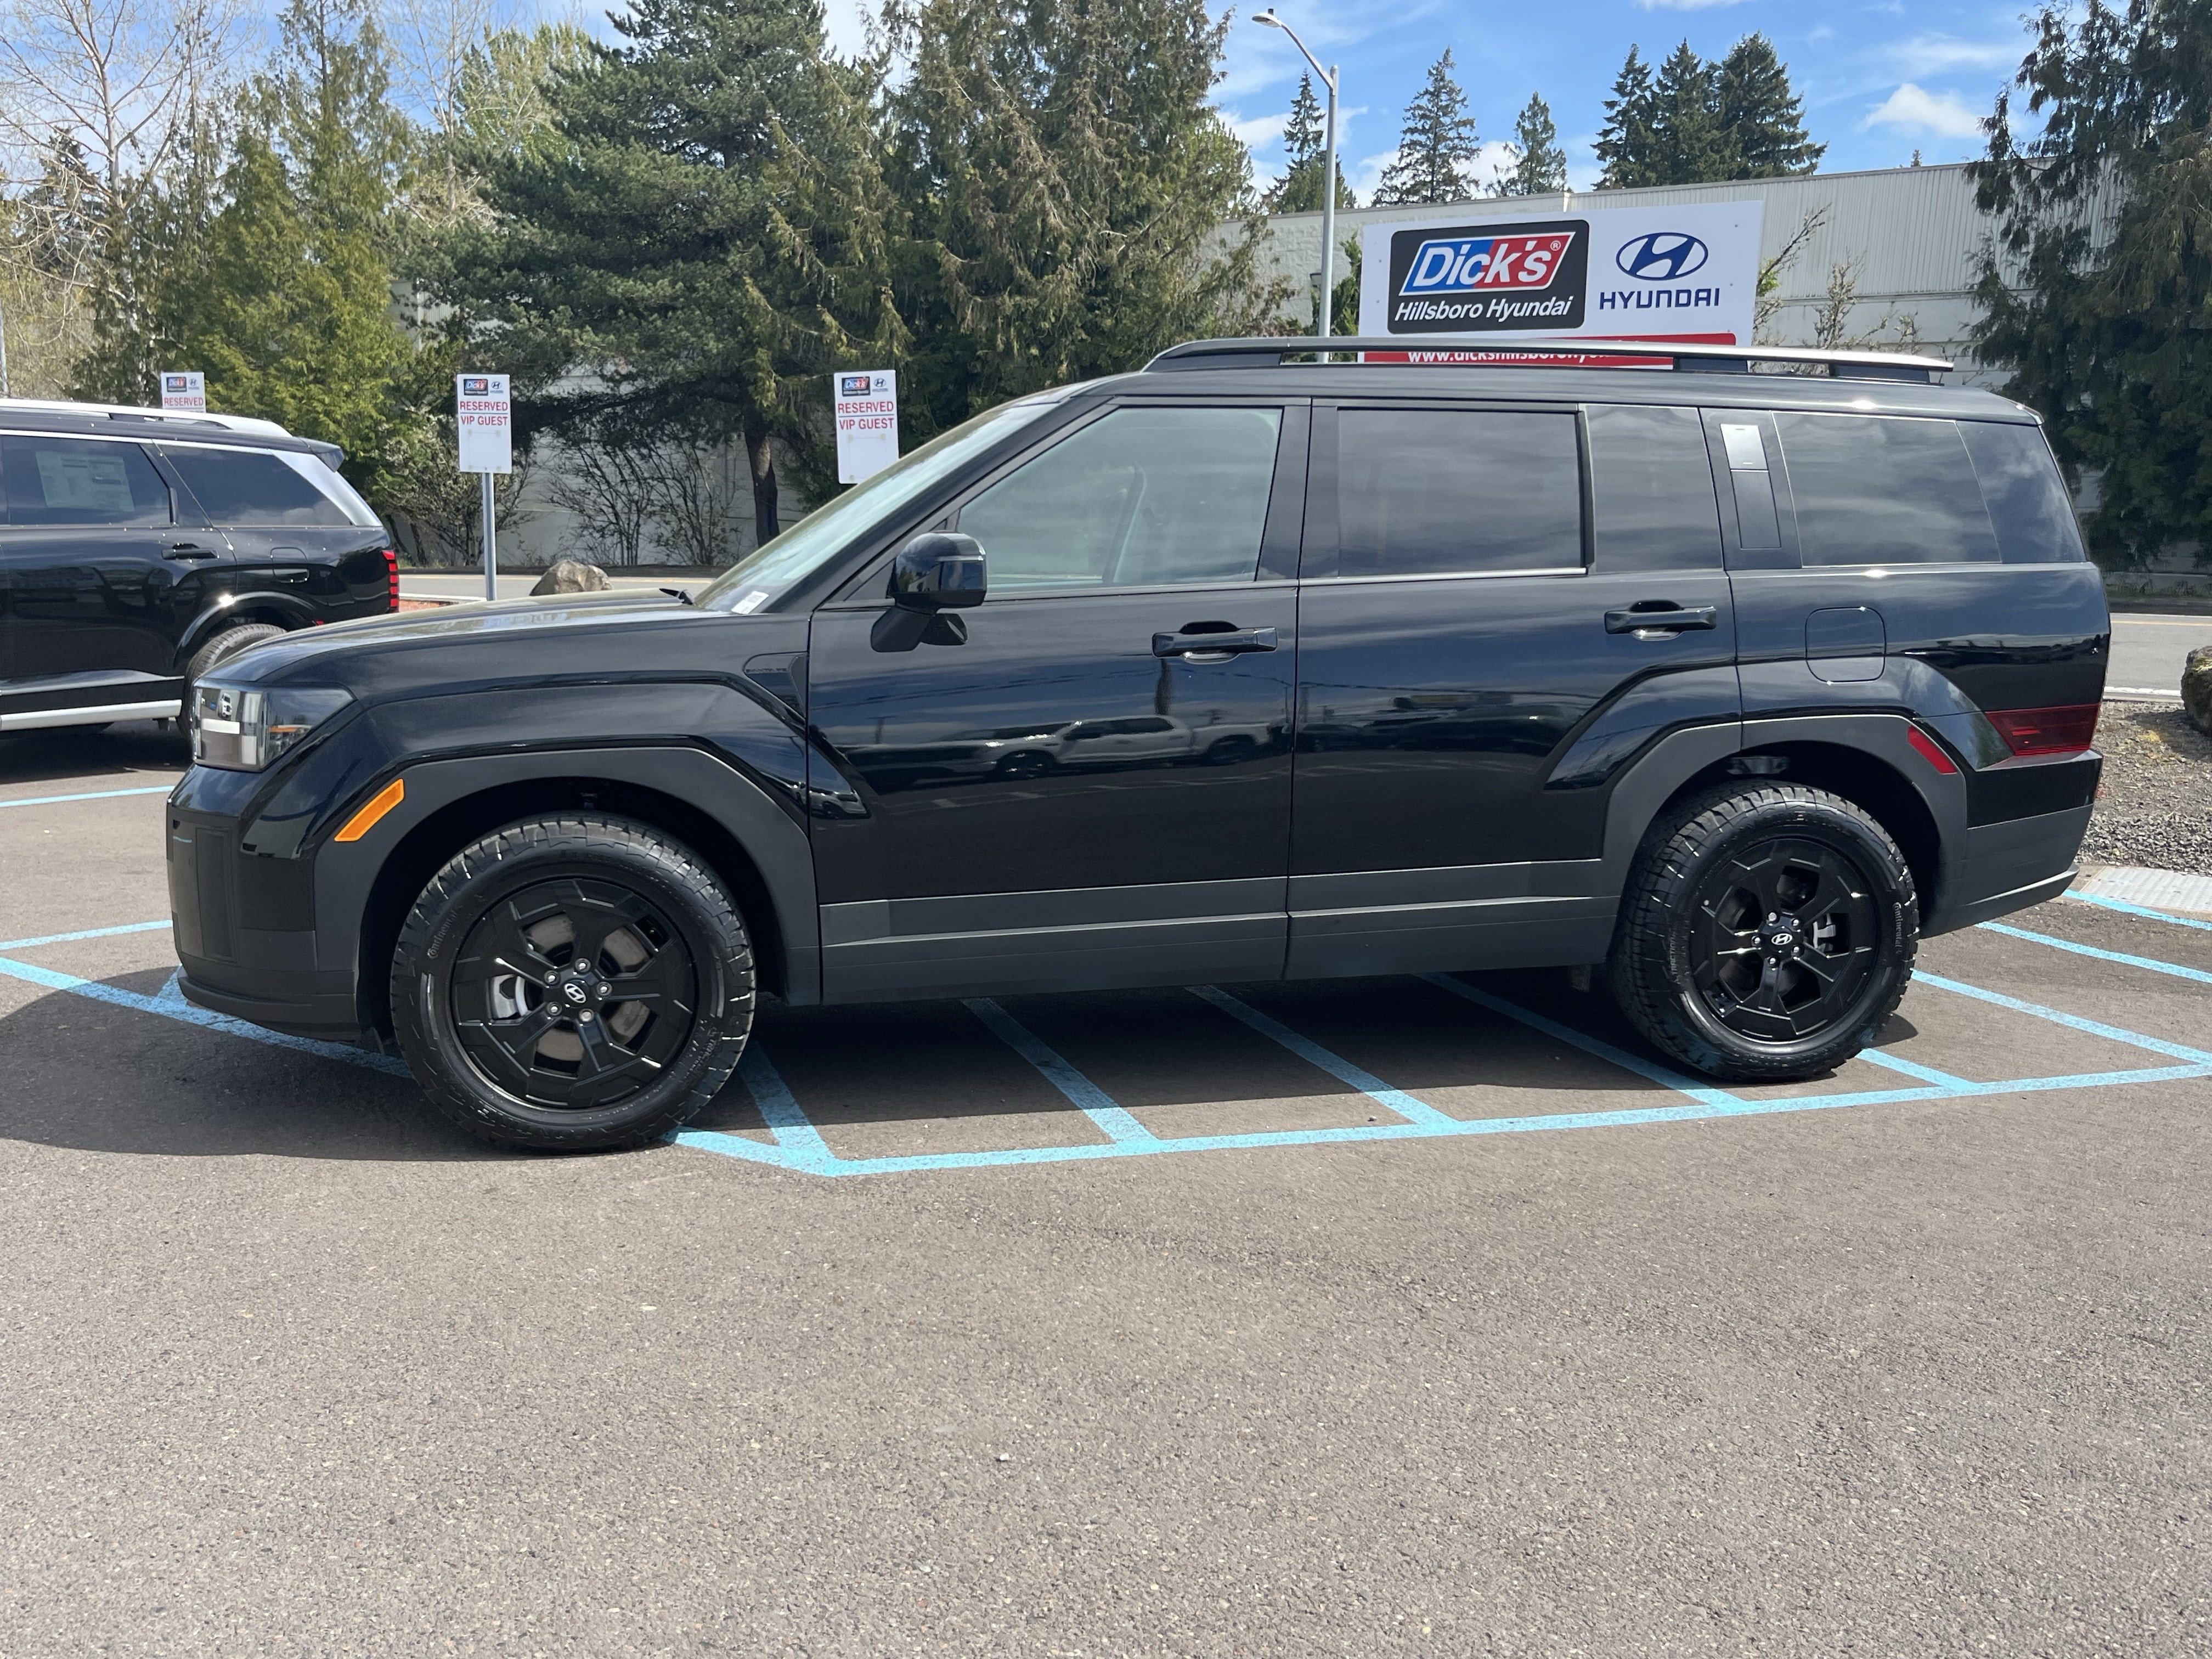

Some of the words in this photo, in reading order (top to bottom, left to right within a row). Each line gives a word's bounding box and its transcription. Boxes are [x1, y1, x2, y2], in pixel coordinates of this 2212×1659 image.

[1599, 287, 1720, 310] HYUNDAI
[1394, 300, 1483, 322] Hillsboro
[1486, 296, 1575, 323] Hyundai
[164, 397, 204, 407] RESERVED
[460, 401, 508, 411] RESERVED
[837, 400, 894, 414] RESERVED
[461, 415, 475, 425] VIP
[477, 415, 509, 426] GUEST
[839, 419, 855, 430] VIP
[858, 417, 894, 430] GUEST
